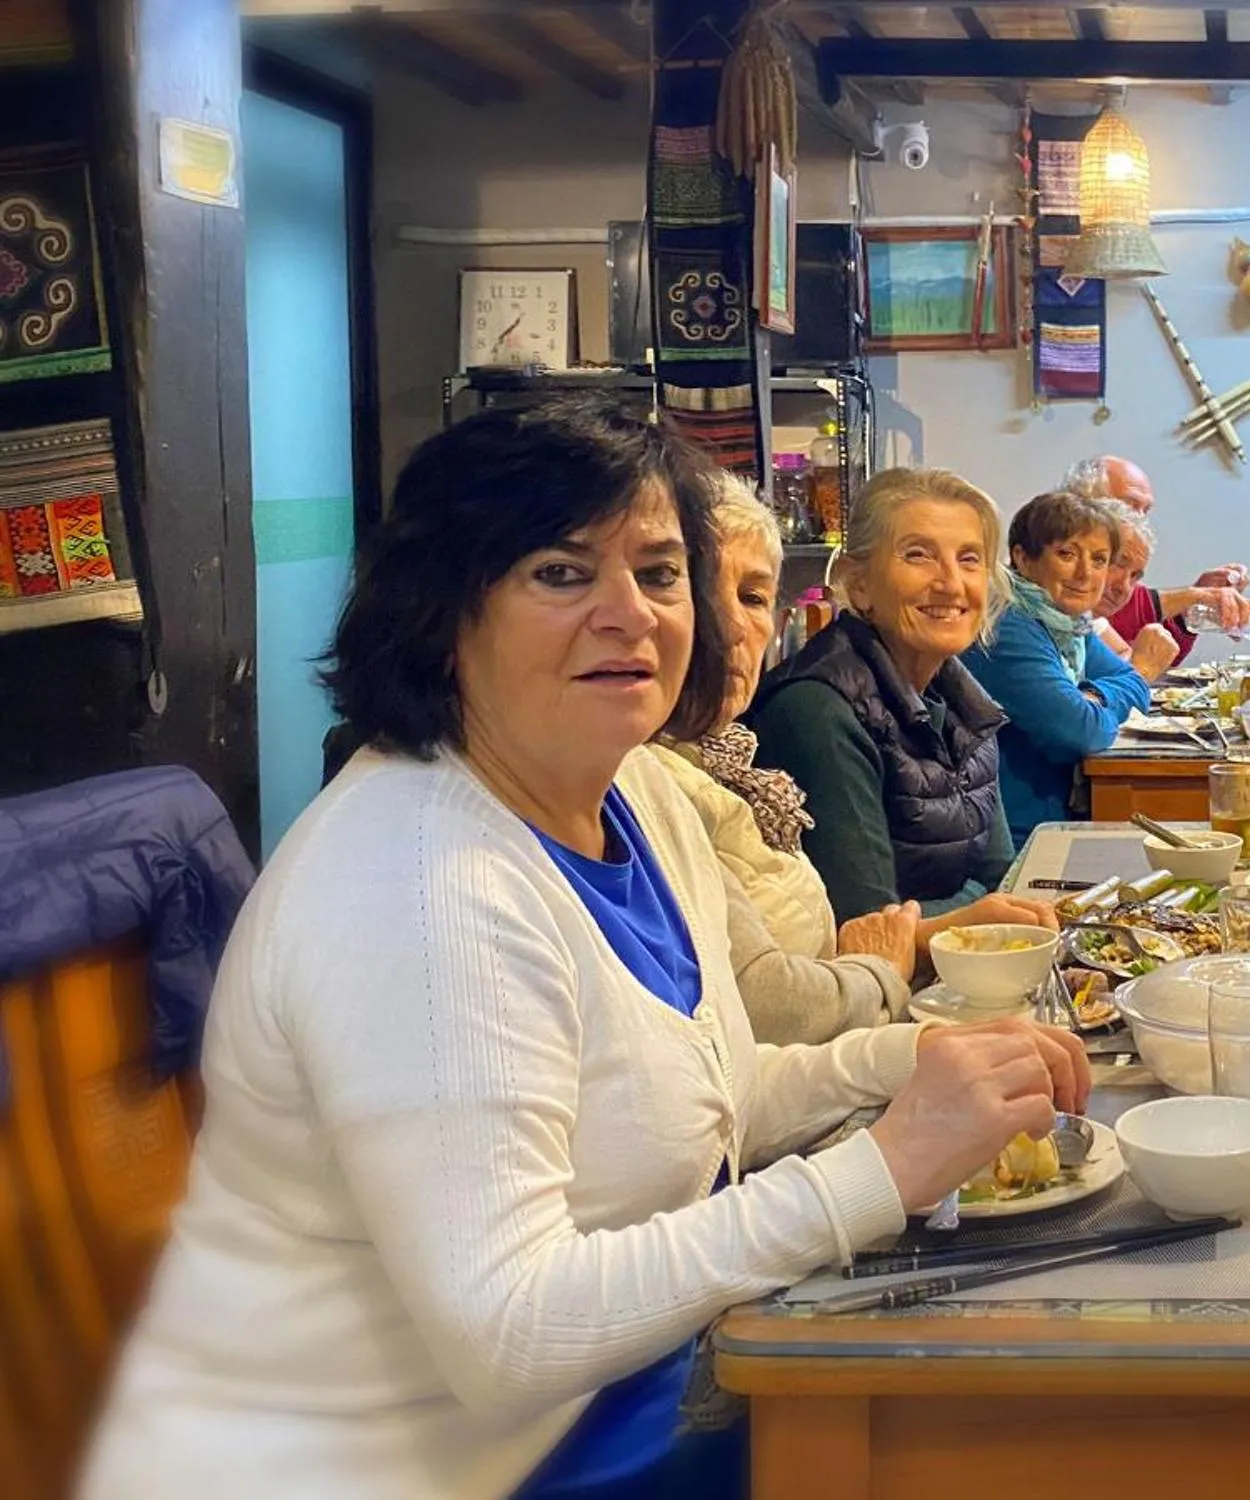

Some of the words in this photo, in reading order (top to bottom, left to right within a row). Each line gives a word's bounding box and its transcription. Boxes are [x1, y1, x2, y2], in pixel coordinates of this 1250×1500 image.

[490, 286, 503, 298] 11
[511, 286, 527, 298] 12
[536, 286, 542, 298] 1
[477, 300, 492, 313] 10
[548, 301, 558, 314] 2
[547, 319, 556, 331] 3
